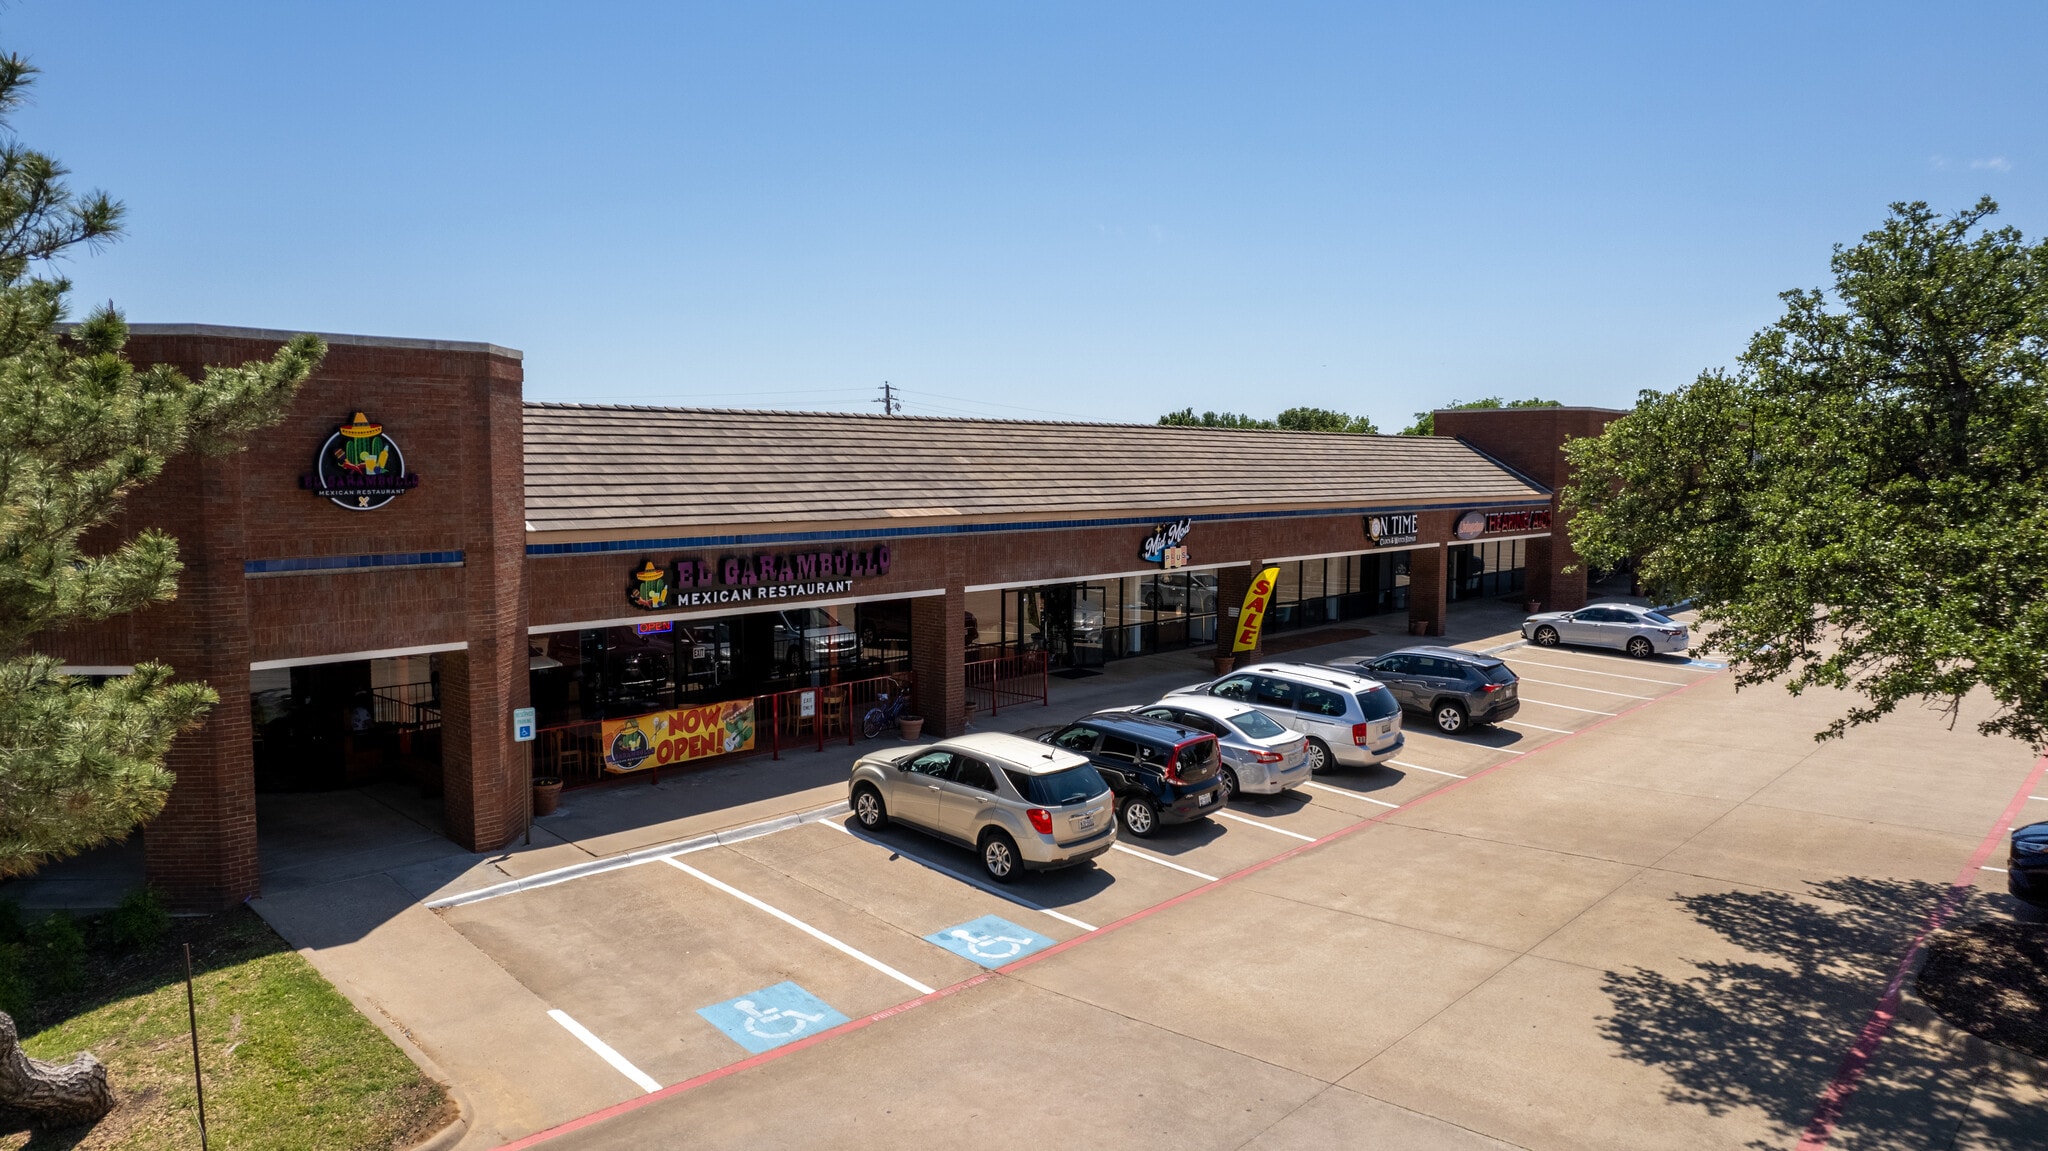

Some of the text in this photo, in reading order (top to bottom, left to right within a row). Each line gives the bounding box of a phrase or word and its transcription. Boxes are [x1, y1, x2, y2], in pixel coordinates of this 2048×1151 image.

[1145, 518, 1192, 557] Mid Mod
[1391, 514, 1418, 535] TIME
[677, 545, 892, 589] EL GARAMBULLO
[1165, 552, 1186, 562] PLUS
[678, 580, 854, 607] MEXICAN RESTAURANT
[639, 620, 671, 633] OPEN
[1238, 579, 1270, 645] SALE
[693, 647, 706, 659] EXIT
[668, 705, 722, 736] NOW
[656, 727, 724, 764] OPEN!
